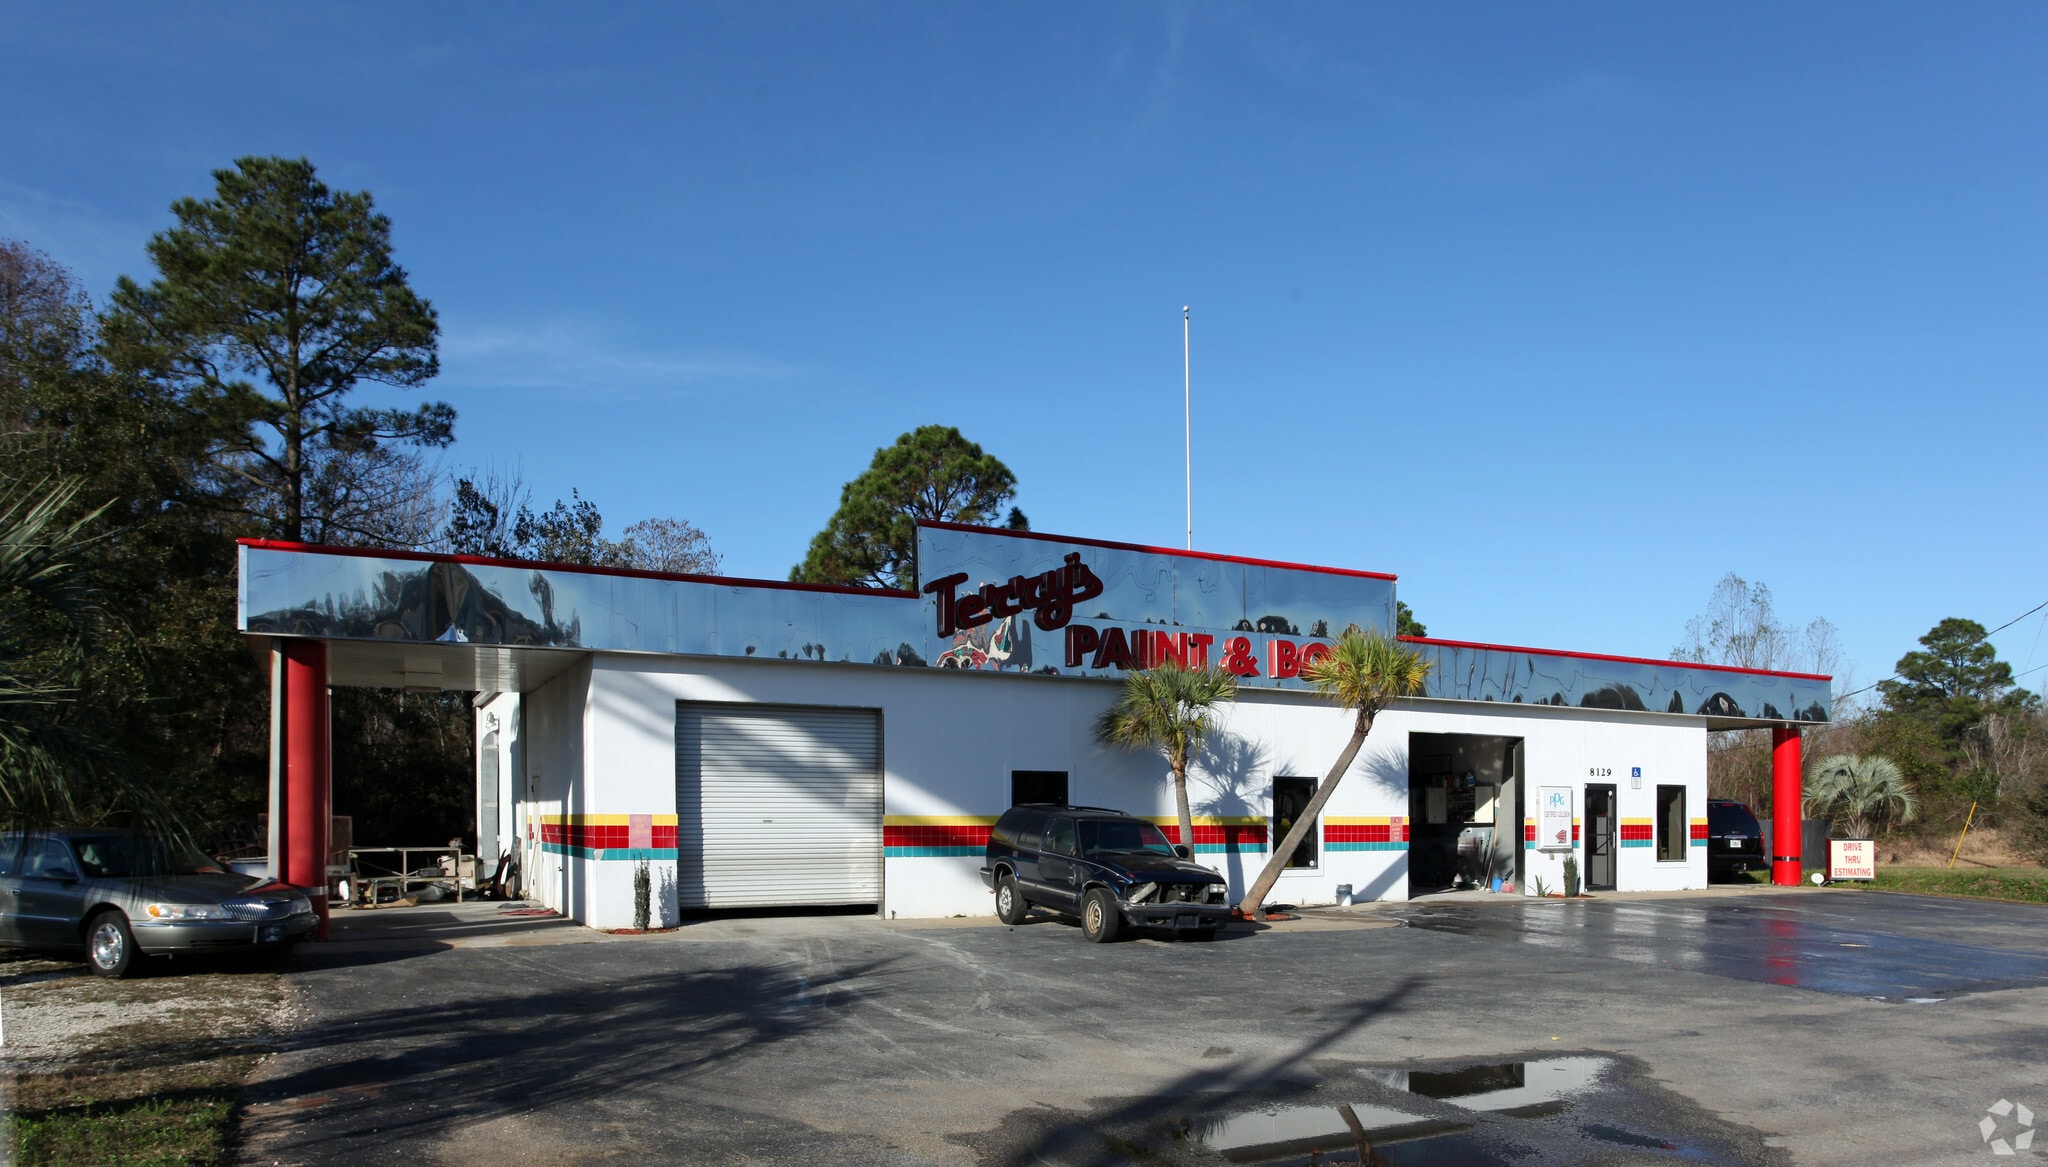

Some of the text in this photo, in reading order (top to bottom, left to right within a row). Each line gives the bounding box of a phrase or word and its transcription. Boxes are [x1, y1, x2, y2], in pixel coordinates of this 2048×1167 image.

[923, 552, 1103, 638] Terry's
[1065, 624, 1376, 683] PAINT & BO
[1590, 768, 1611, 776] 8129
[1843, 843, 1862, 851] DRIVE
[1845, 856, 1861, 864] THRU
[1834, 868, 1871, 876] ESTIMATING
